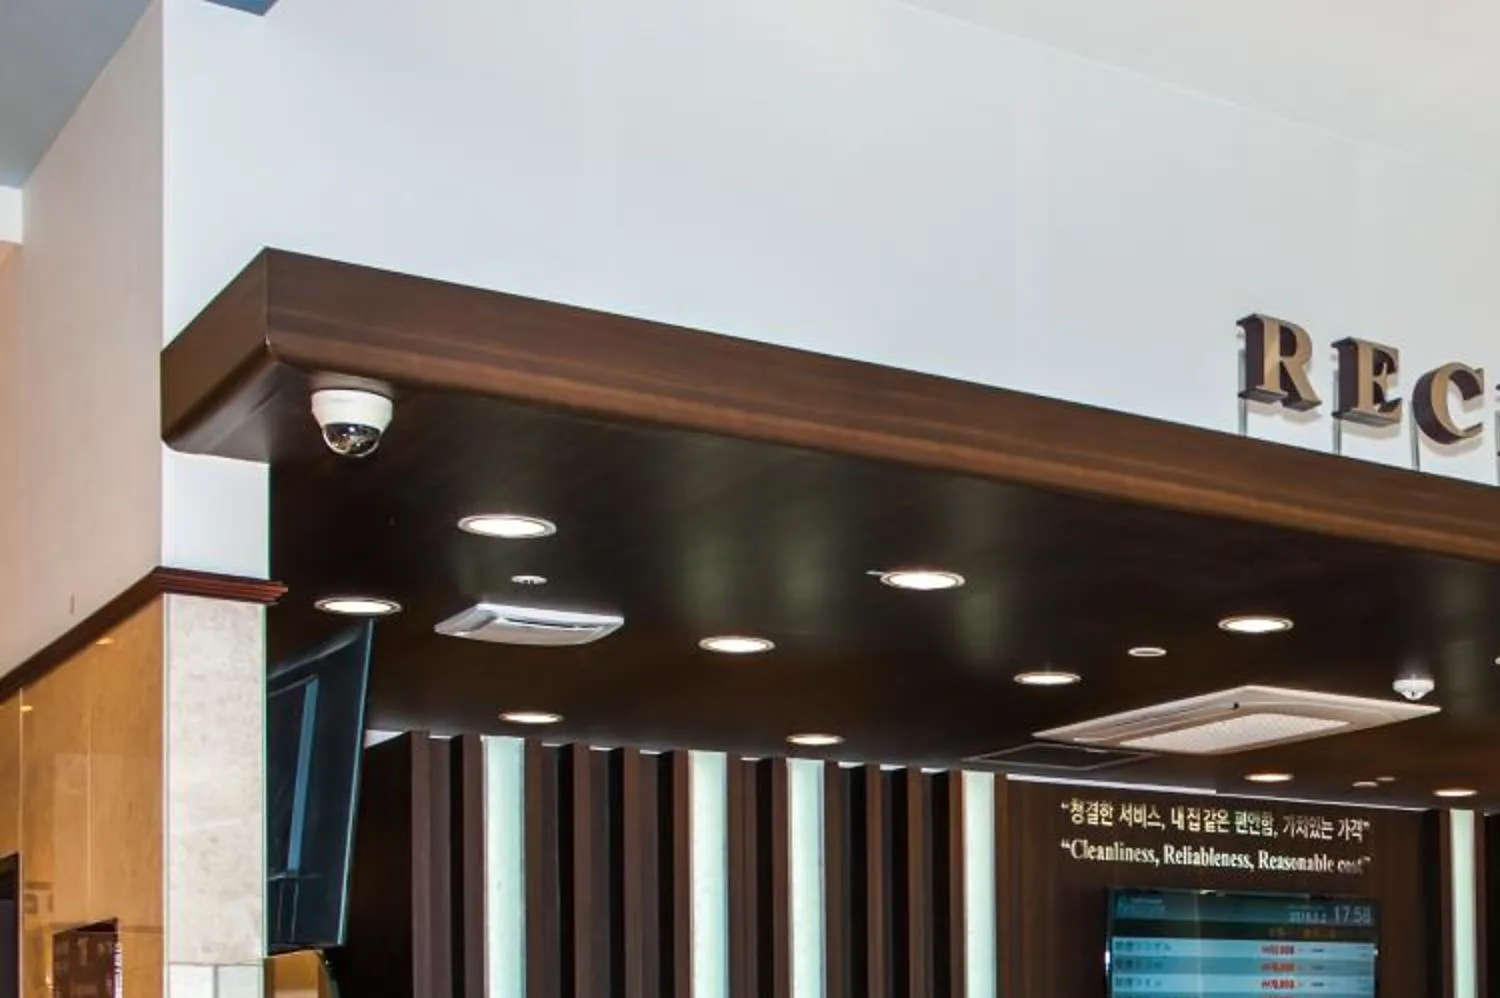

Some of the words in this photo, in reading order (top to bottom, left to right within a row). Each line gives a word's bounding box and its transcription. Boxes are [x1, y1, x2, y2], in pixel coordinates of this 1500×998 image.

[1119, 802, 1166, 831] 서비스,
[1163, 843, 1255, 873] Reliableness,
[1258, 849, 1335, 874] Reasonable
